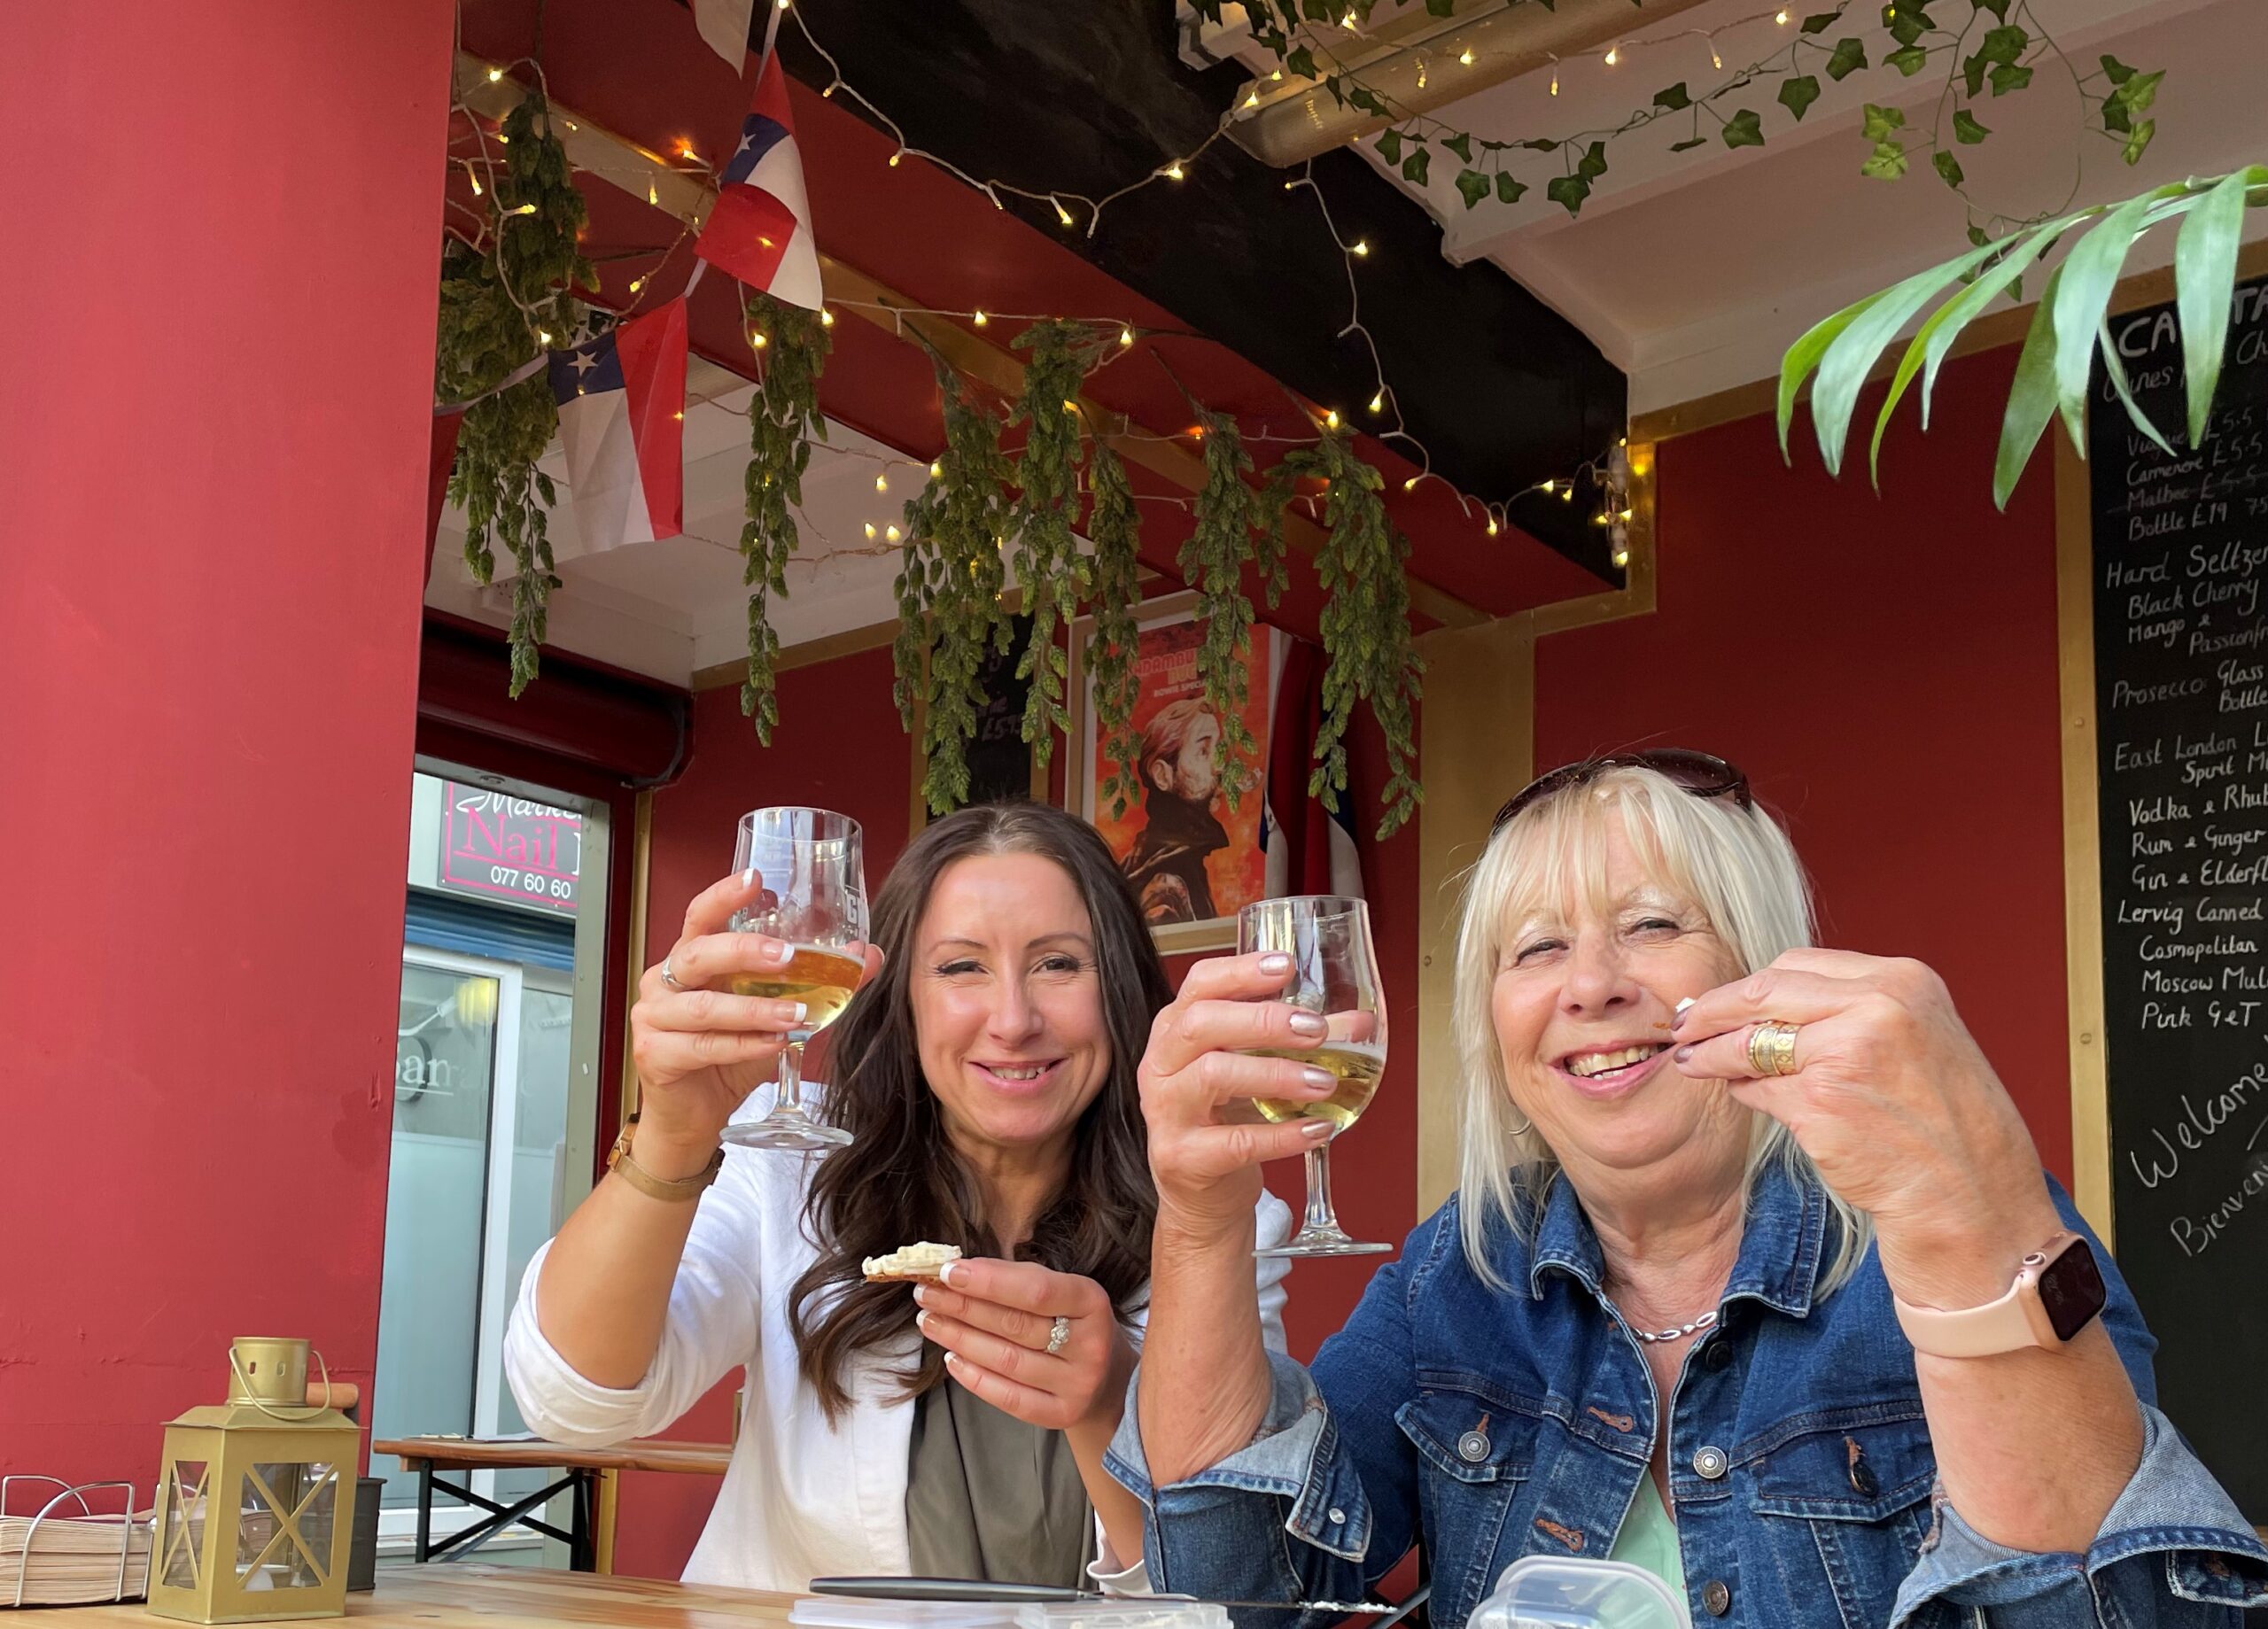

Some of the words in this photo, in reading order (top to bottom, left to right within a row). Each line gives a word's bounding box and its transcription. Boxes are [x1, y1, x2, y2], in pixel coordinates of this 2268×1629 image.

[2129, 511, 2186, 541] Bottle
[2107, 551, 2170, 588] Hard
[2128, 586, 2184, 619] Black
[2193, 578, 2259, 616] Cherry
[2129, 619, 2186, 648] Mango
[2218, 659, 2264, 687] Glass
[2115, 738, 2163, 772] East
[2175, 733, 2237, 760] London
[2129, 795, 2192, 826] Vodka
[462, 806, 558, 870] Nail
[2132, 831, 2173, 857] Rum
[2204, 825, 2266, 856] Ginger
[490, 865, 518, 887] 077
[524, 873, 545, 894] 60
[550, 879, 571, 900] 60
[2132, 864, 2168, 892] Gin
[2118, 899, 2184, 935] Lervig
[2196, 896, 2264, 921] Canned
[2140, 935, 2259, 963] Cosmopolitan
[2142, 970, 2213, 993] Moscow
[2141, 1002, 2193, 1029] Pink
[2131, 1063, 2268, 1188] Welcome
